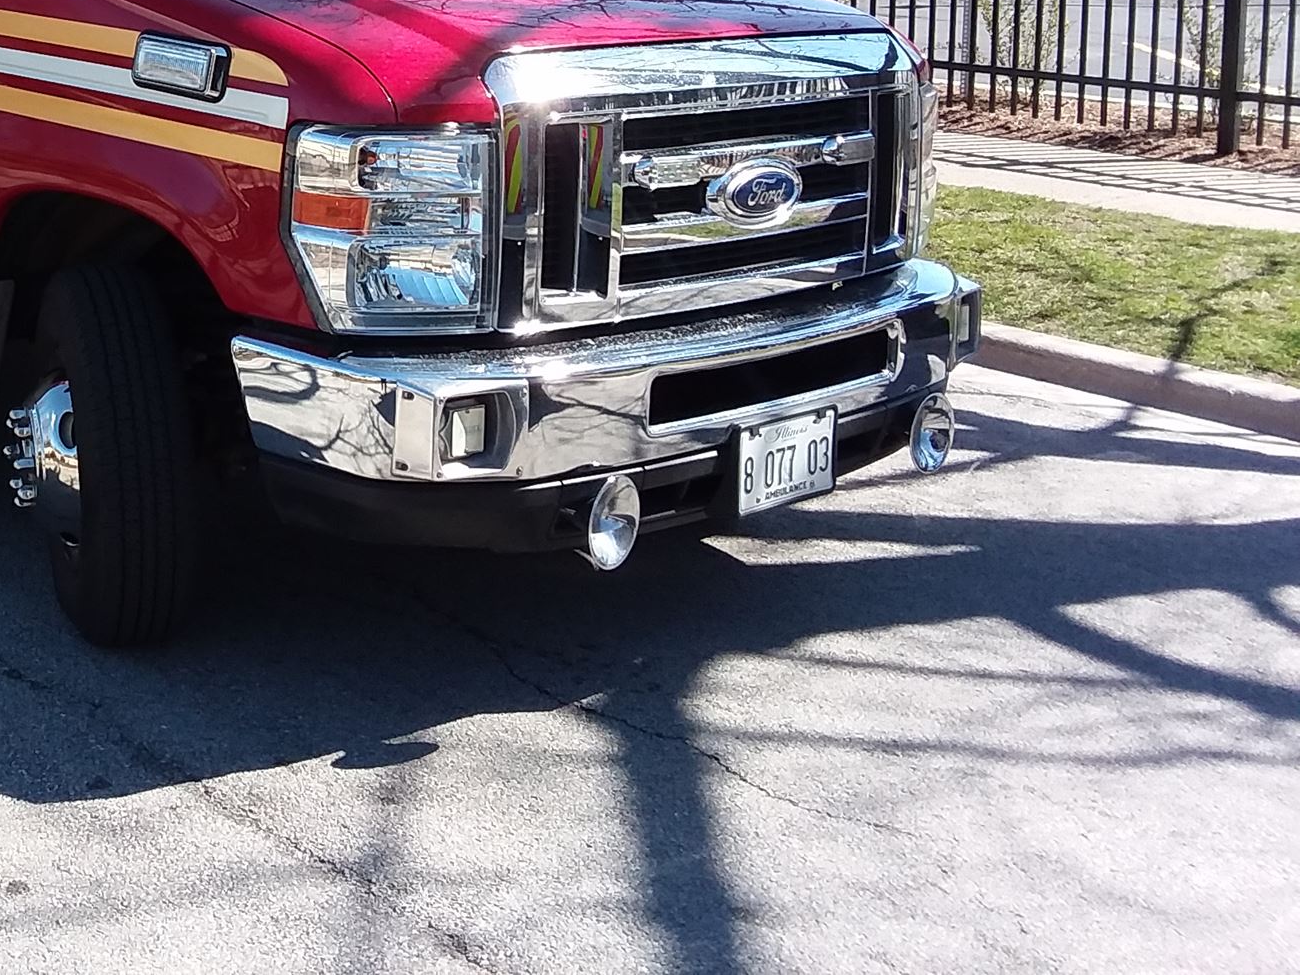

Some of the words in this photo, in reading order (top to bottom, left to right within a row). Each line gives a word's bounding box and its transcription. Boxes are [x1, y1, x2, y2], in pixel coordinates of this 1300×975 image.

[747, 177, 786, 207] Ford
[744, 456, 754, 494] 8
[764, 444, 797, 489] 077
[807, 436, 829, 476] 03
[764, 480, 807, 500] AMBULANCE
